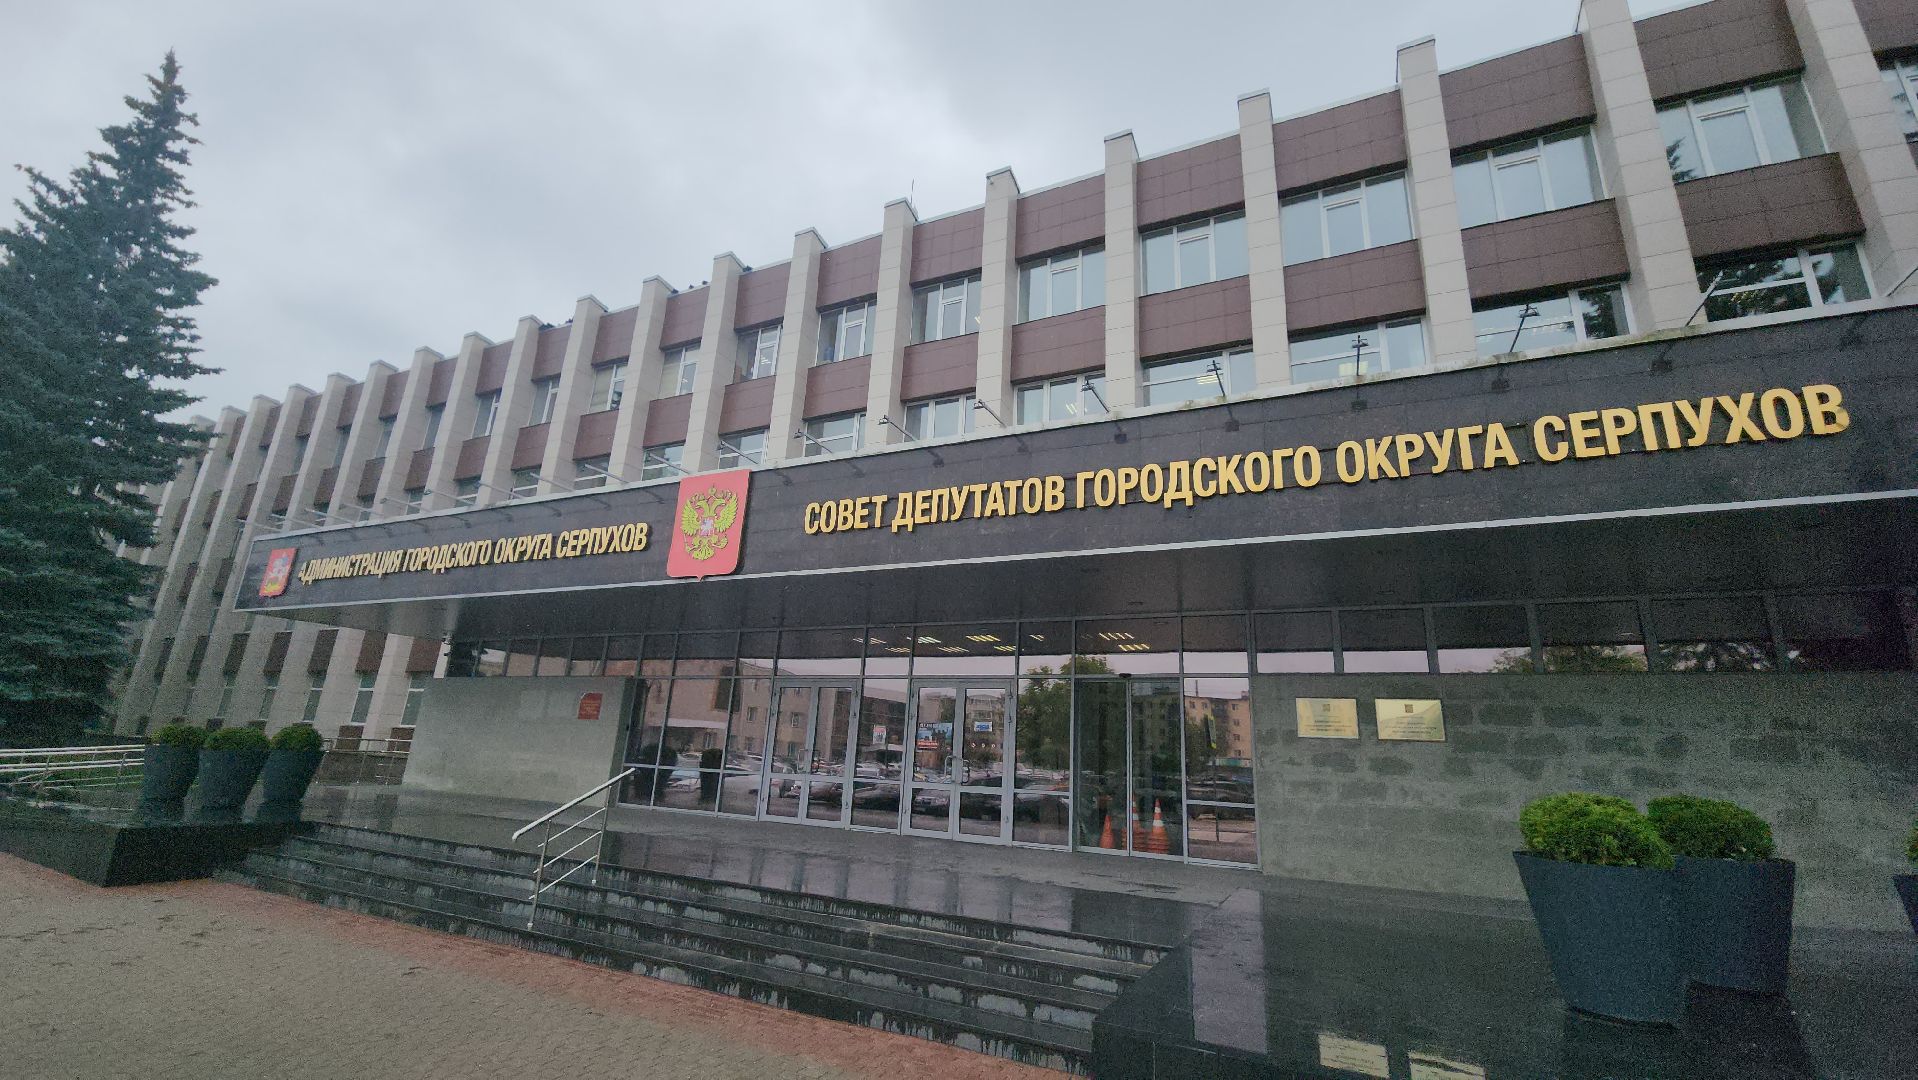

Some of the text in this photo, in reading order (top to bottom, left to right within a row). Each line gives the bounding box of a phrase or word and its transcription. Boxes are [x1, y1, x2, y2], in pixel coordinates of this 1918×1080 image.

[804, 383, 1851, 535] СОВЕТ ДЕПУТАТОВ ГОРОДСКОГО ОКРУГА СЕРПУХОВ
[297, 523, 648, 586] АДМИНИСТРАЦИЯ ГОРОДСКОГО ОКРУГА СЕРПУХОВ
